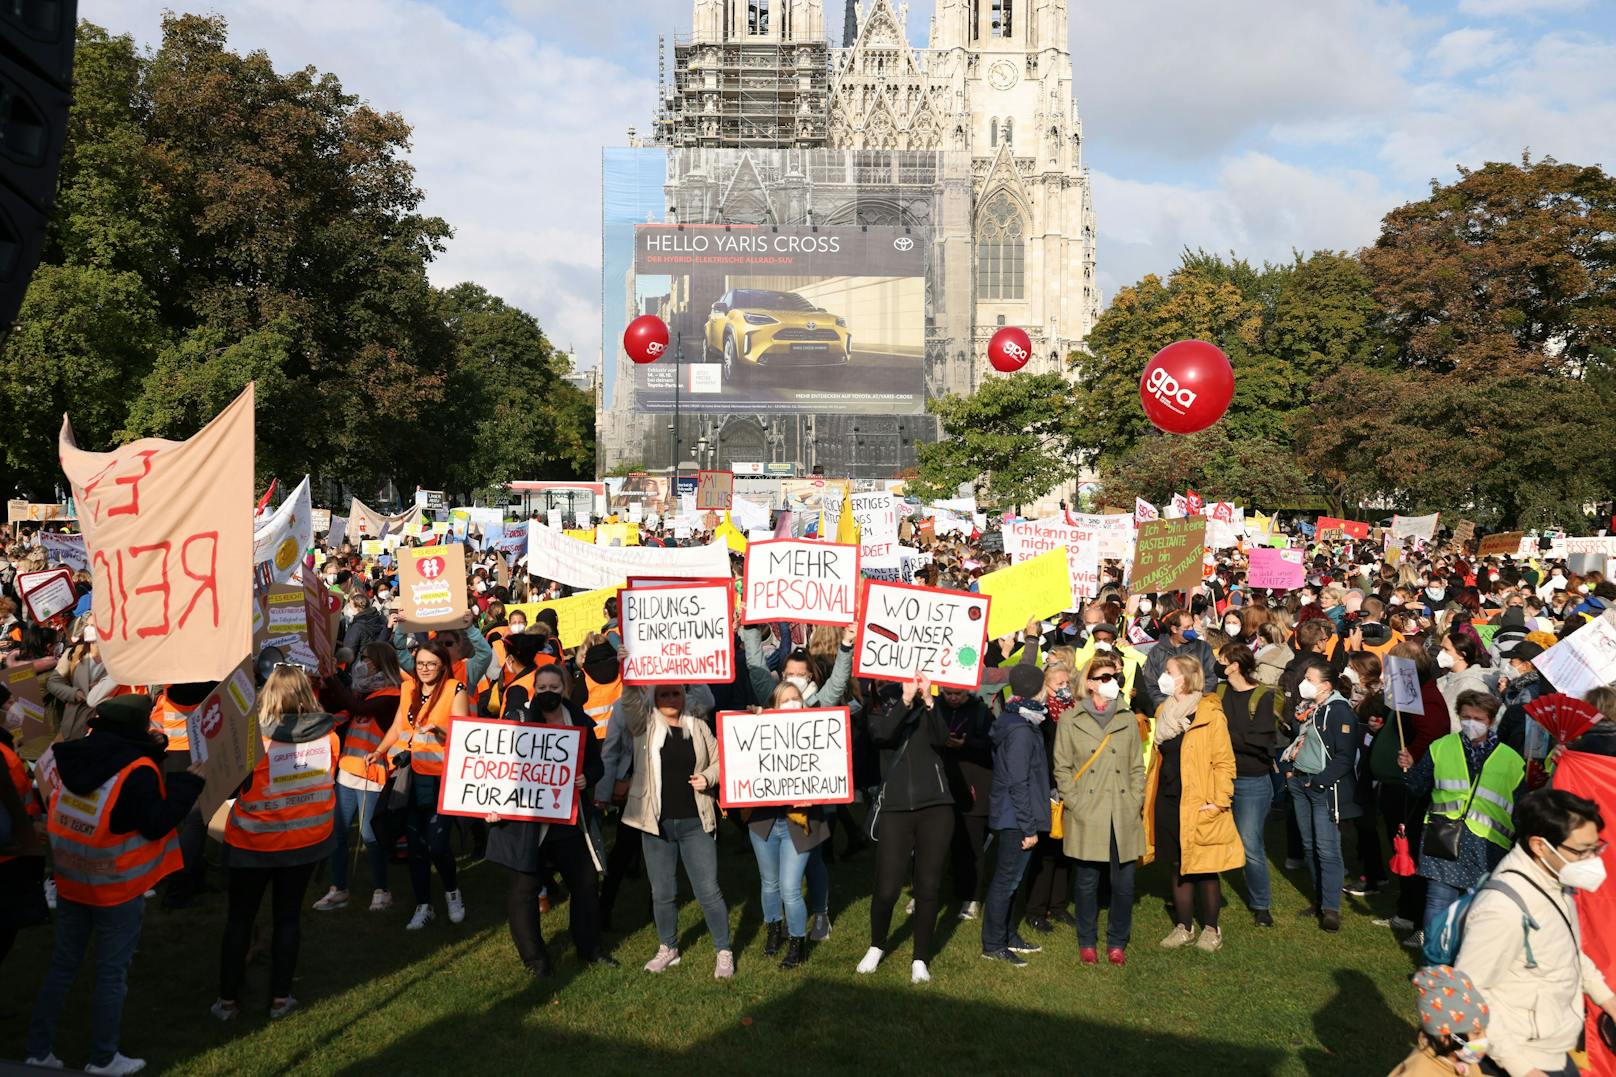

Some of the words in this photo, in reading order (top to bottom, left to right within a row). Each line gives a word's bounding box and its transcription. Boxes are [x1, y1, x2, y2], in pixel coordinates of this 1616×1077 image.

[646, 235, 708, 251] HELLO
[714, 236, 768, 252] YARIS
[774, 236, 840, 252] CROSS
[745, 256, 793, 264] ALLRAD-SUV
[1003, 341, 1028, 360] gpa
[1146, 368, 1197, 408] gpa
[1012, 523, 1032, 535] Ich
[1034, 524, 1067, 540] kann
[1070, 530, 1093, 542] gar
[1145, 525, 1159, 536] Ich
[1183, 521, 1204, 532] keine
[1021, 537, 1055, 550] nicht
[1065, 545, 1079, 554] so
[1139, 534, 1187, 551] BASTELTANTE
[1566, 540, 1606, 553] BESSERES
[769, 550, 840, 579] MEHR
[1141, 552, 1153, 565] ich
[1072, 571, 1096, 582] wie
[628, 595, 706, 621] BILDUNGS-
[753, 579, 854, 614] PERSONAL
[883, 594, 920, 620] WO
[925, 601, 959, 622] IST
[638, 617, 724, 642] EINRICHTUNG
[899, 623, 953, 646] UNSER
[661, 642, 692, 656] KEINE
[624, 650, 727, 677] AUFBEWAHRUNG!!
[464, 728, 570, 763] GLEICHES
[734, 717, 842, 752] WENIGER
[460, 755, 571, 786] FÖRDERGELD
[758, 752, 822, 773] KINDER
[461, 783, 501, 806] FÜR
[733, 780, 751, 799] IM
[752, 776, 848, 799] GRUPPENRAUM
